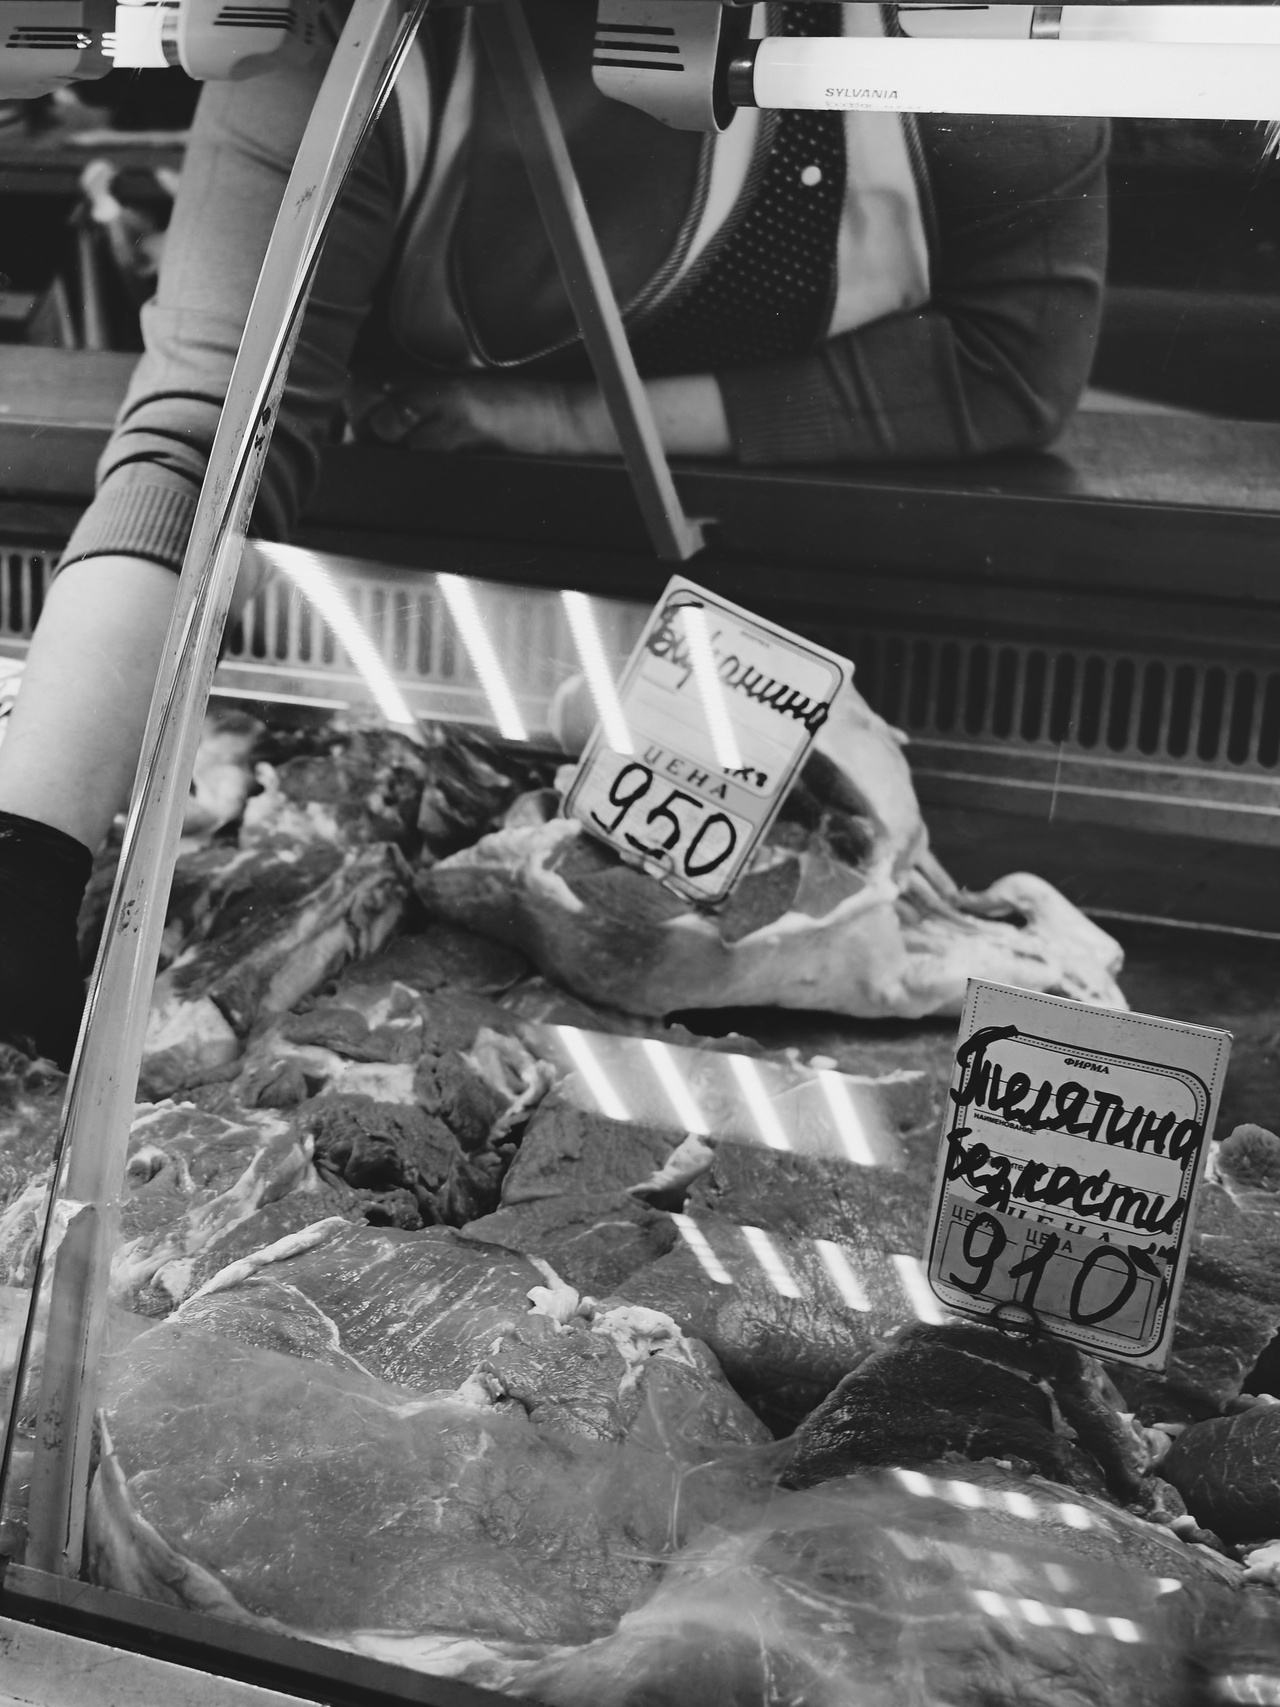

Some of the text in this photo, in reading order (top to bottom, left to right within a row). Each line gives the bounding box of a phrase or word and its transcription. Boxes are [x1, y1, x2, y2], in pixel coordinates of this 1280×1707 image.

[825, 87, 898, 99] SYLVANIA
[643, 745, 728, 800] ЦЕНА
[591, 762, 737, 878] 950
[1064, 1057, 1110, 1075] ФИРМА
[949, 1212, 1138, 1326] 910
